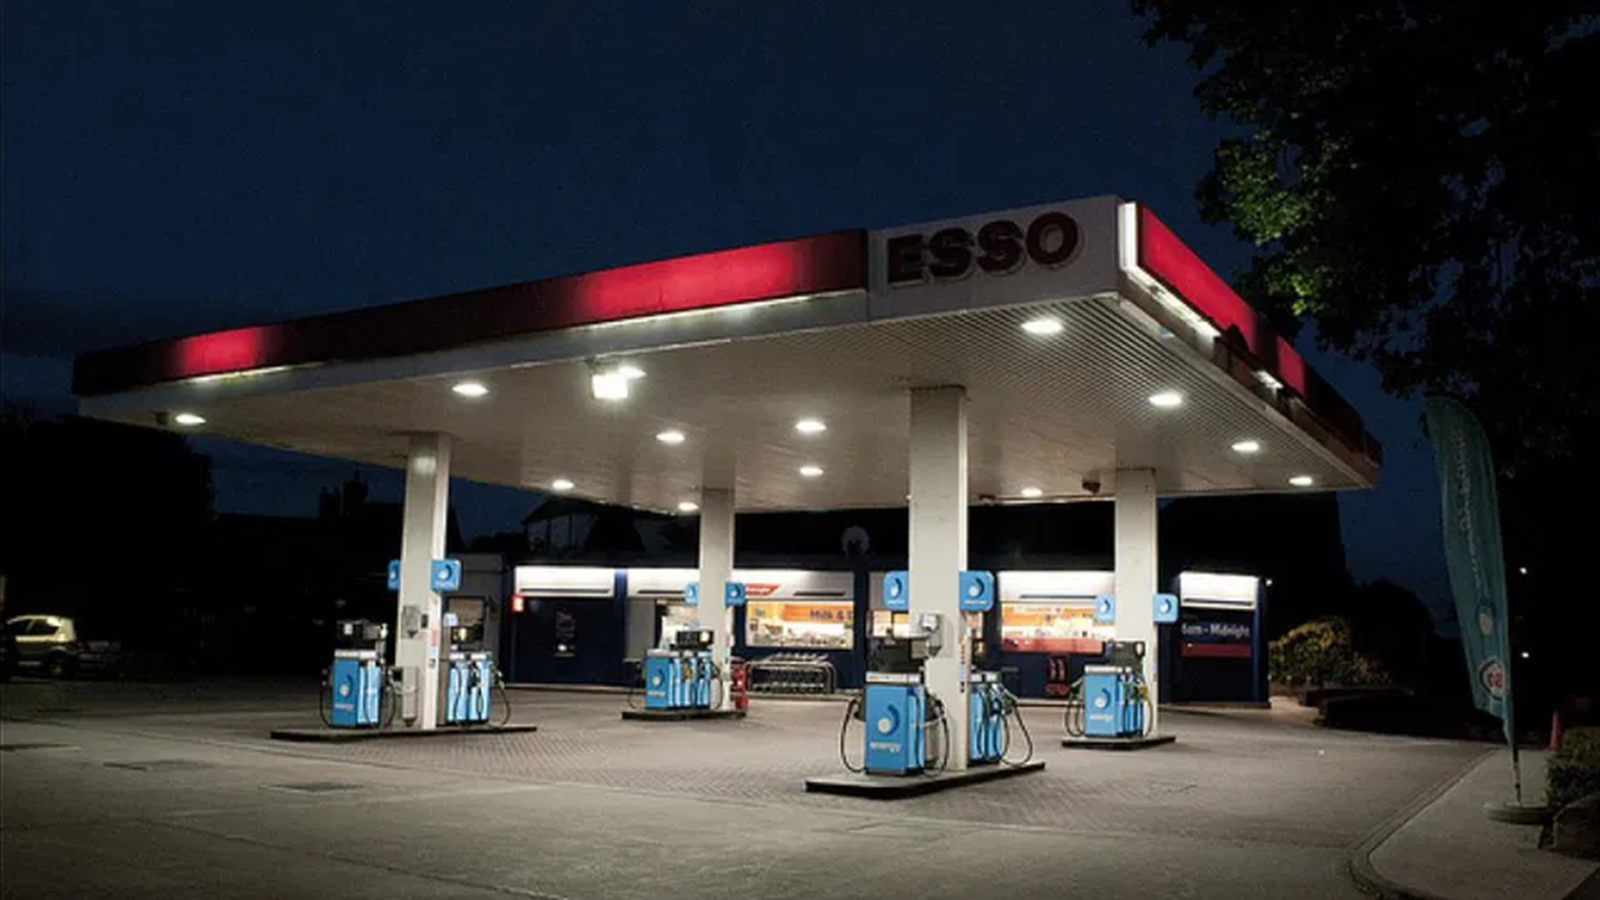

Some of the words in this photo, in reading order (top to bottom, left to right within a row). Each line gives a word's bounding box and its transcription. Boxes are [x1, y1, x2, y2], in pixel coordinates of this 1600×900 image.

[887, 211, 1082, 285] ESSO
[1210, 623, 1250, 640] Midnight
[869, 741, 902, 753] energy
